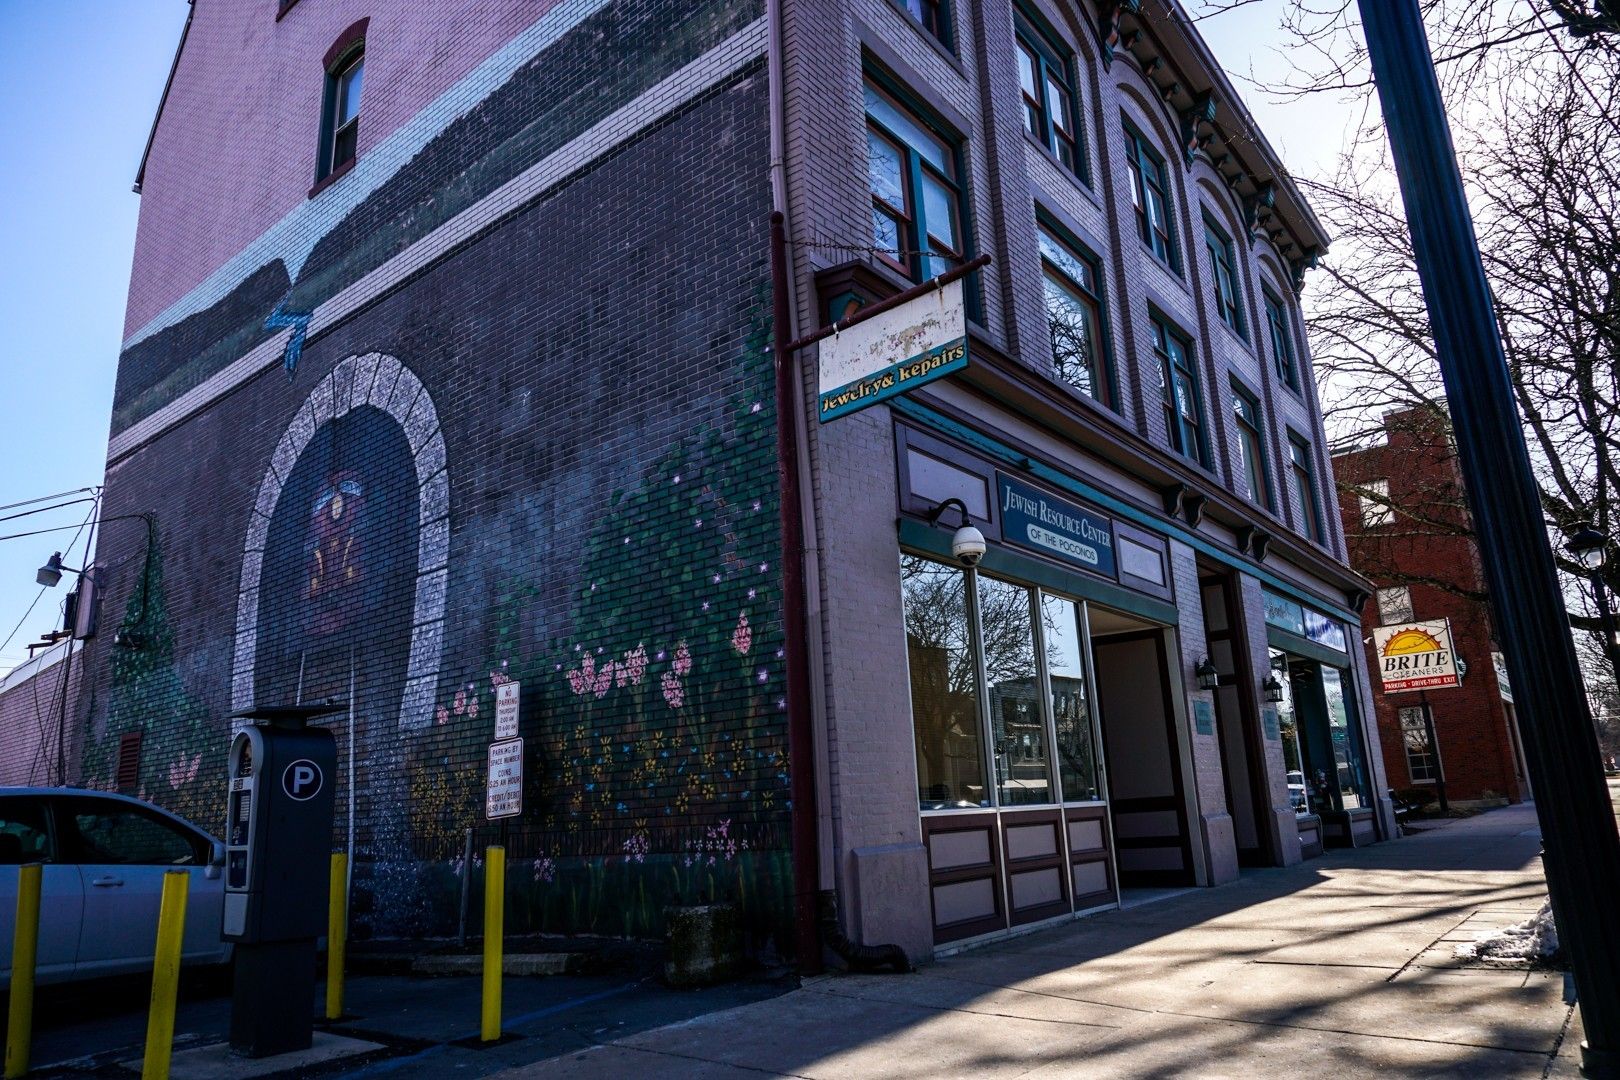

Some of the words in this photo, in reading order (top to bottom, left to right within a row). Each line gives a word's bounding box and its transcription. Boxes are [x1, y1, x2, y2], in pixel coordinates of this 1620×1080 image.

[1003, 485, 1038, 518] JEWISH
[1039, 500, 1080, 535] RESOURCE
[1081, 518, 1111, 548] CENTER
[1030, 528, 1042, 540] OF
[1044, 533, 1057, 546] THE
[1059, 539, 1096, 561] POCONOS
[1384, 651, 1449, 672] BRITE
[1392, 666, 1444, 680] CLEANERS
[1384, 681, 1407, 690] PARKING
[1411, 677, 1442, 687] DRIVE-THRU
[1443, 676, 1456, 684] EXIT
[505, 689, 512, 697] NO
[498, 697, 518, 706] PARKING
[492, 747, 511, 757] PARKING
[512, 745, 519, 753] BY
[490, 758, 503, 767] SPACE
[503, 755, 520, 764] NUMBER
[497, 768, 512, 778] COINS
[293, 766, 315, 794] P
[500, 778, 507, 786] AN
[507, 775, 520, 785] HOUR
[488, 789, 520, 803] CREDIT/DEBIT
[499, 803, 506, 811] AN
[507, 800, 520, 810] HOUR
